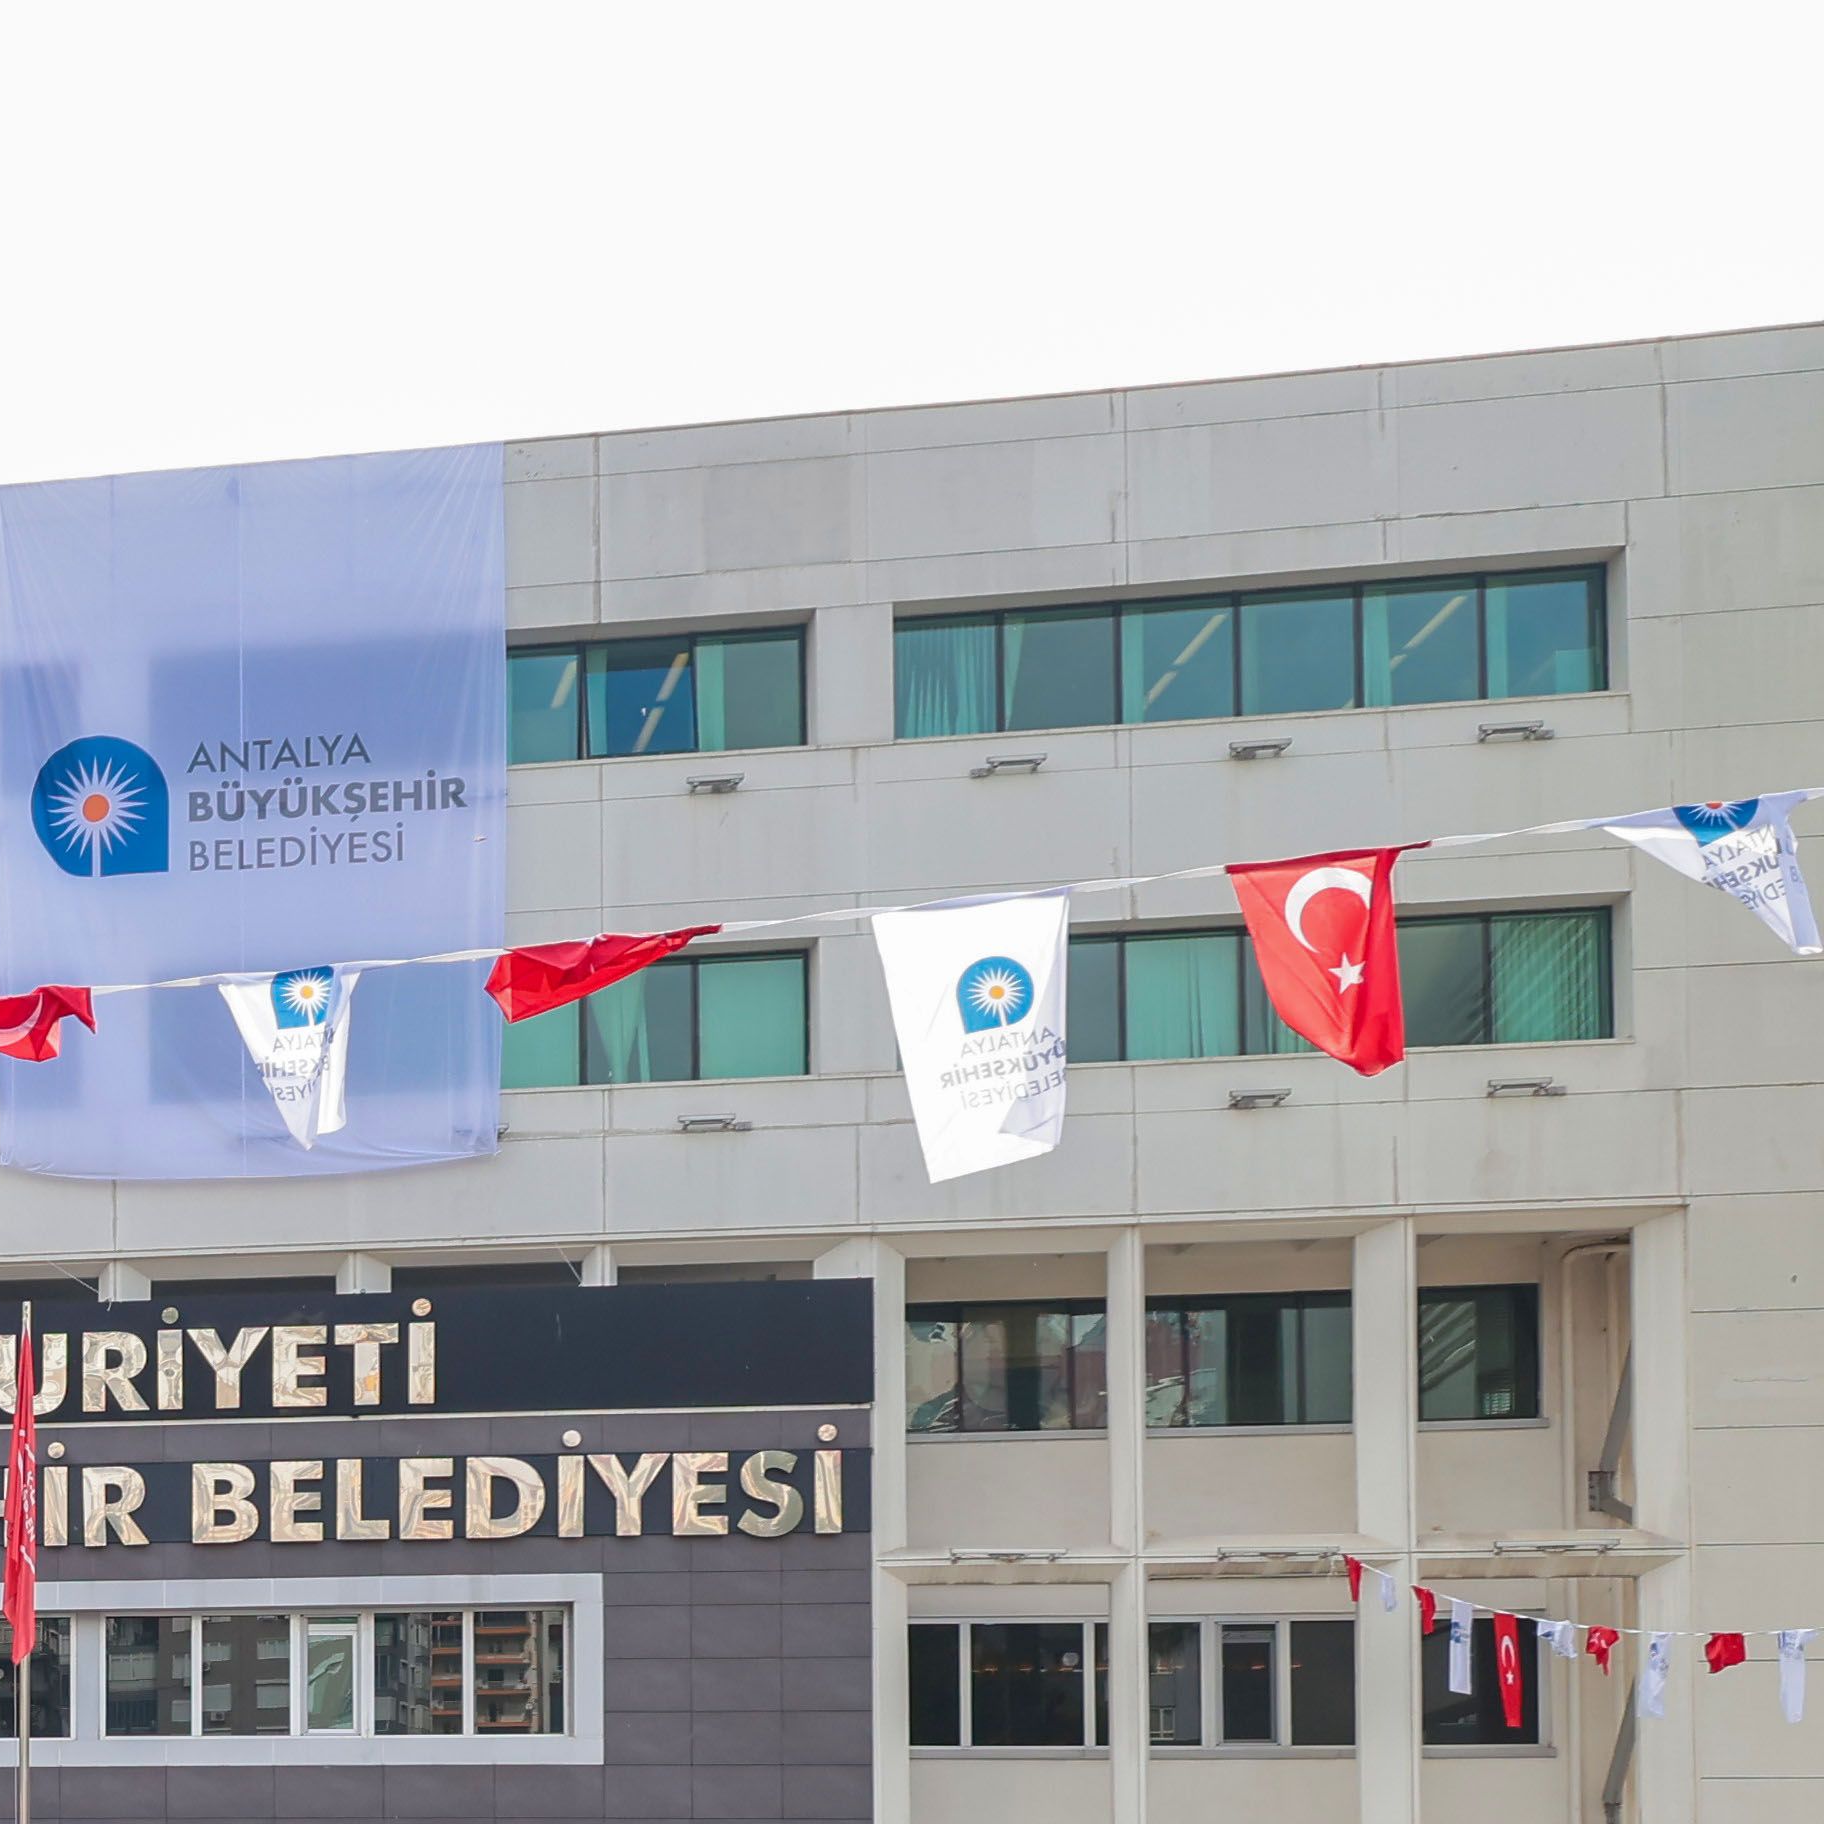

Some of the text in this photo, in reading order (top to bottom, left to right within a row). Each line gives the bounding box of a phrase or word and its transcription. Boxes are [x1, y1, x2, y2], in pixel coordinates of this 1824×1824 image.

[186, 732, 372, 774] ANTALYA
[187, 769, 469, 828] BÜYÜKŞEHİR
[189, 821, 405, 873] BELEDİYESİ
[191, 1424, 842, 1544] BELEDİYESİ
